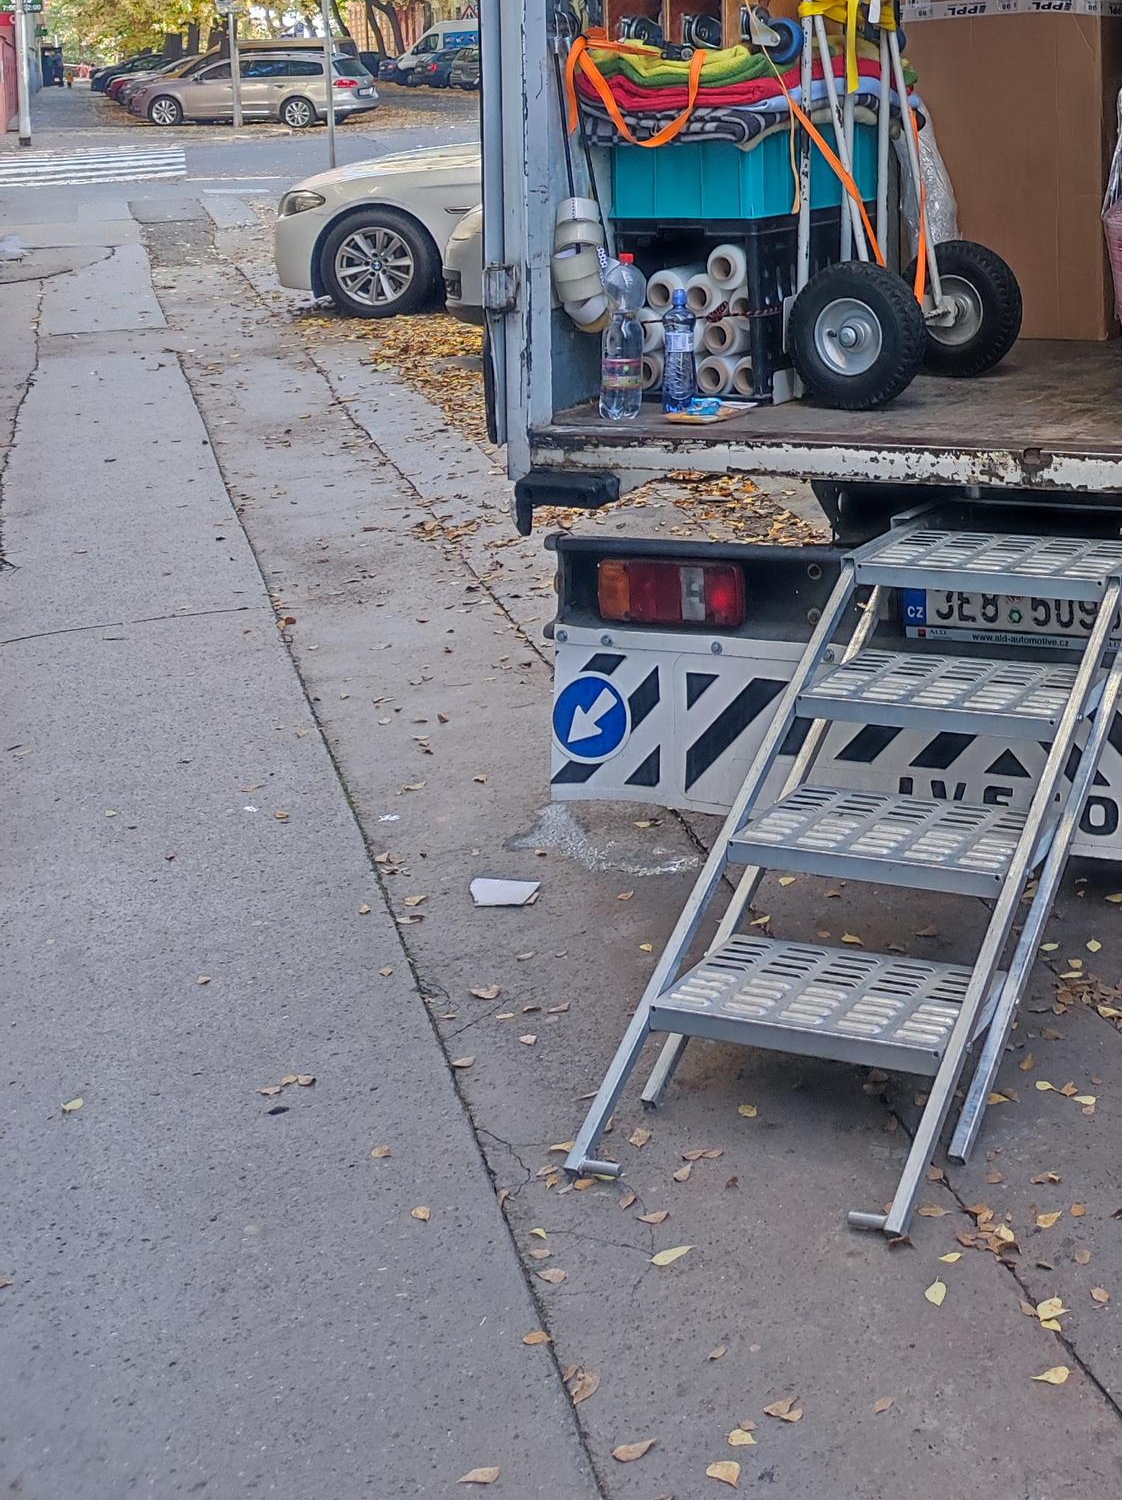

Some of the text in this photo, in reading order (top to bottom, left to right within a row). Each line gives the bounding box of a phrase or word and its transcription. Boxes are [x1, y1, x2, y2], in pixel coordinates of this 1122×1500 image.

[907, 605, 924, 619] CZ
[1031, 596, 1121, 632] 509
[971, 632, 1069, 648] www.ald-automotive.cz
